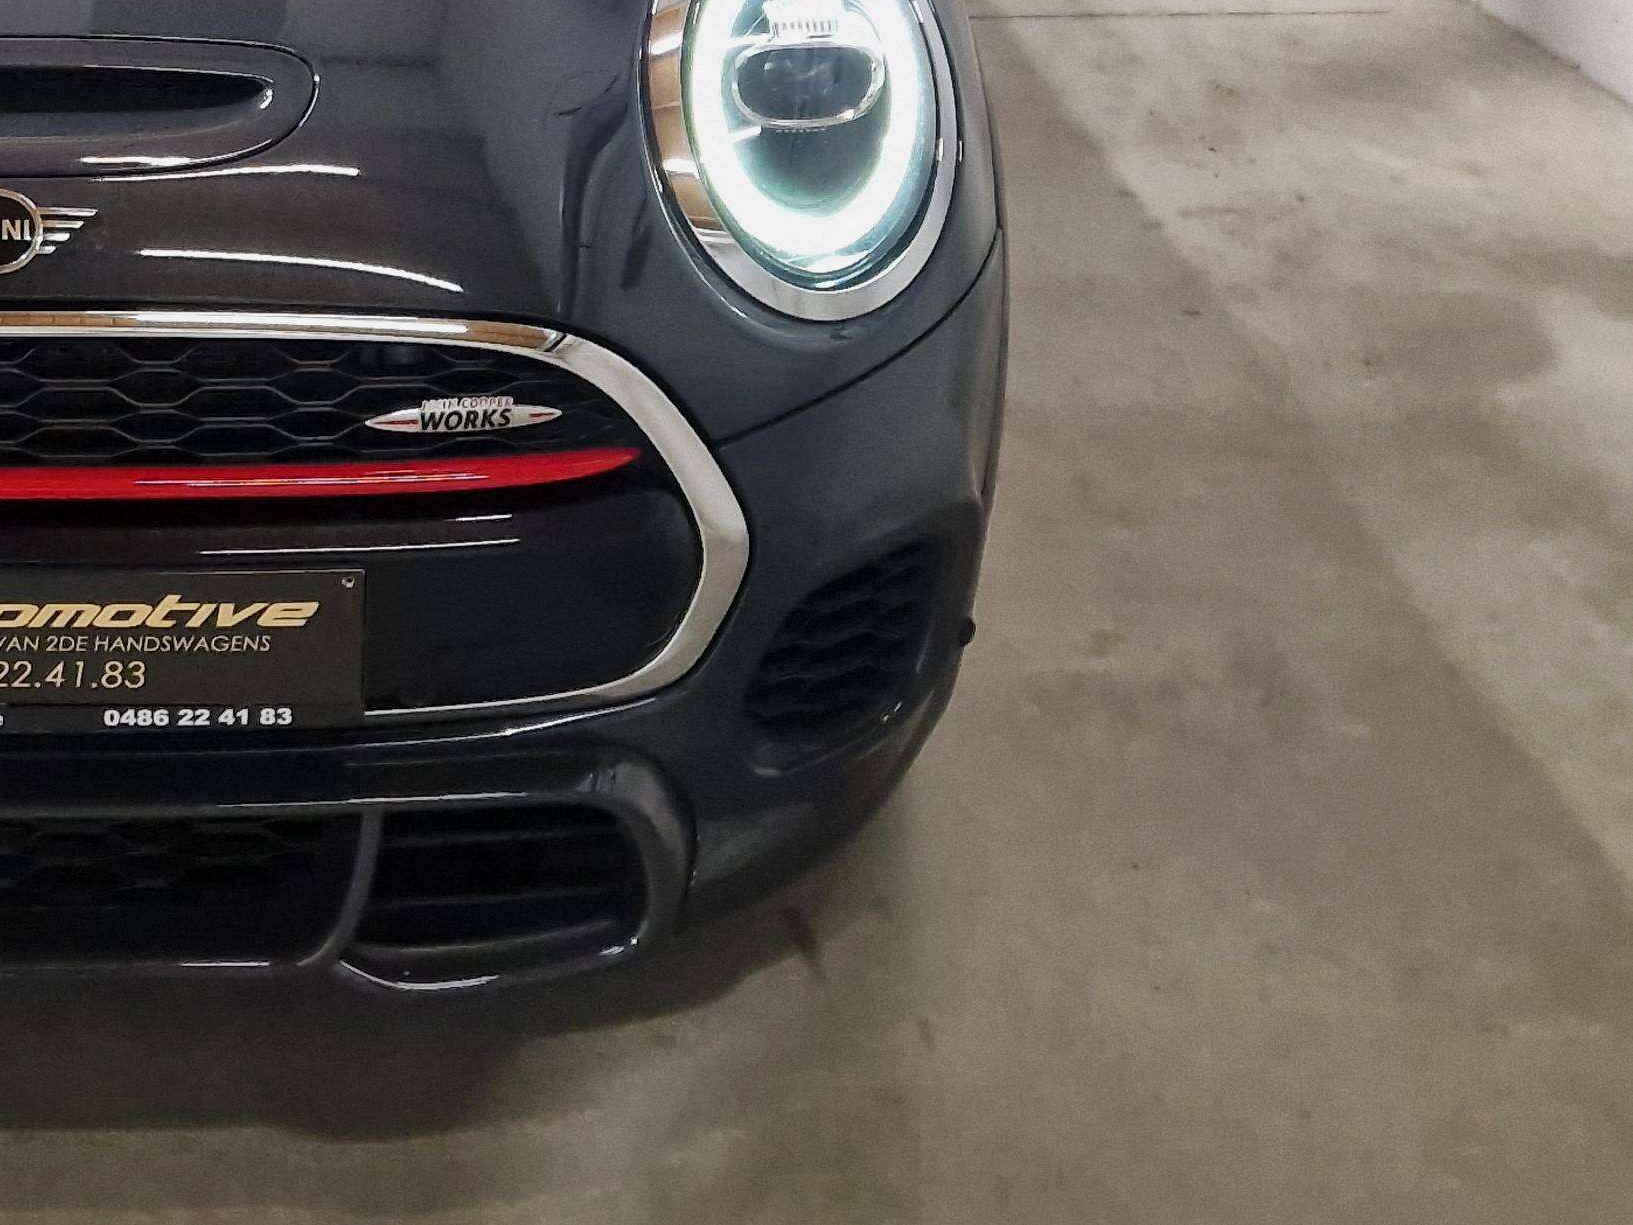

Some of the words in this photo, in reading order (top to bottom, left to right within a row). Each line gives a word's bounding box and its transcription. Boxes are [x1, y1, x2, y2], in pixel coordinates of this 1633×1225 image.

[420, 409, 512, 431] WORKS
[45, 635, 88, 652] 2DE
[94, 635, 271, 652] HANDSWAGENS
[103, 708, 169, 726] 0486
[177, 709, 211, 726] 22
[217, 709, 249, 726] 41
[259, 708, 293, 726] 83
